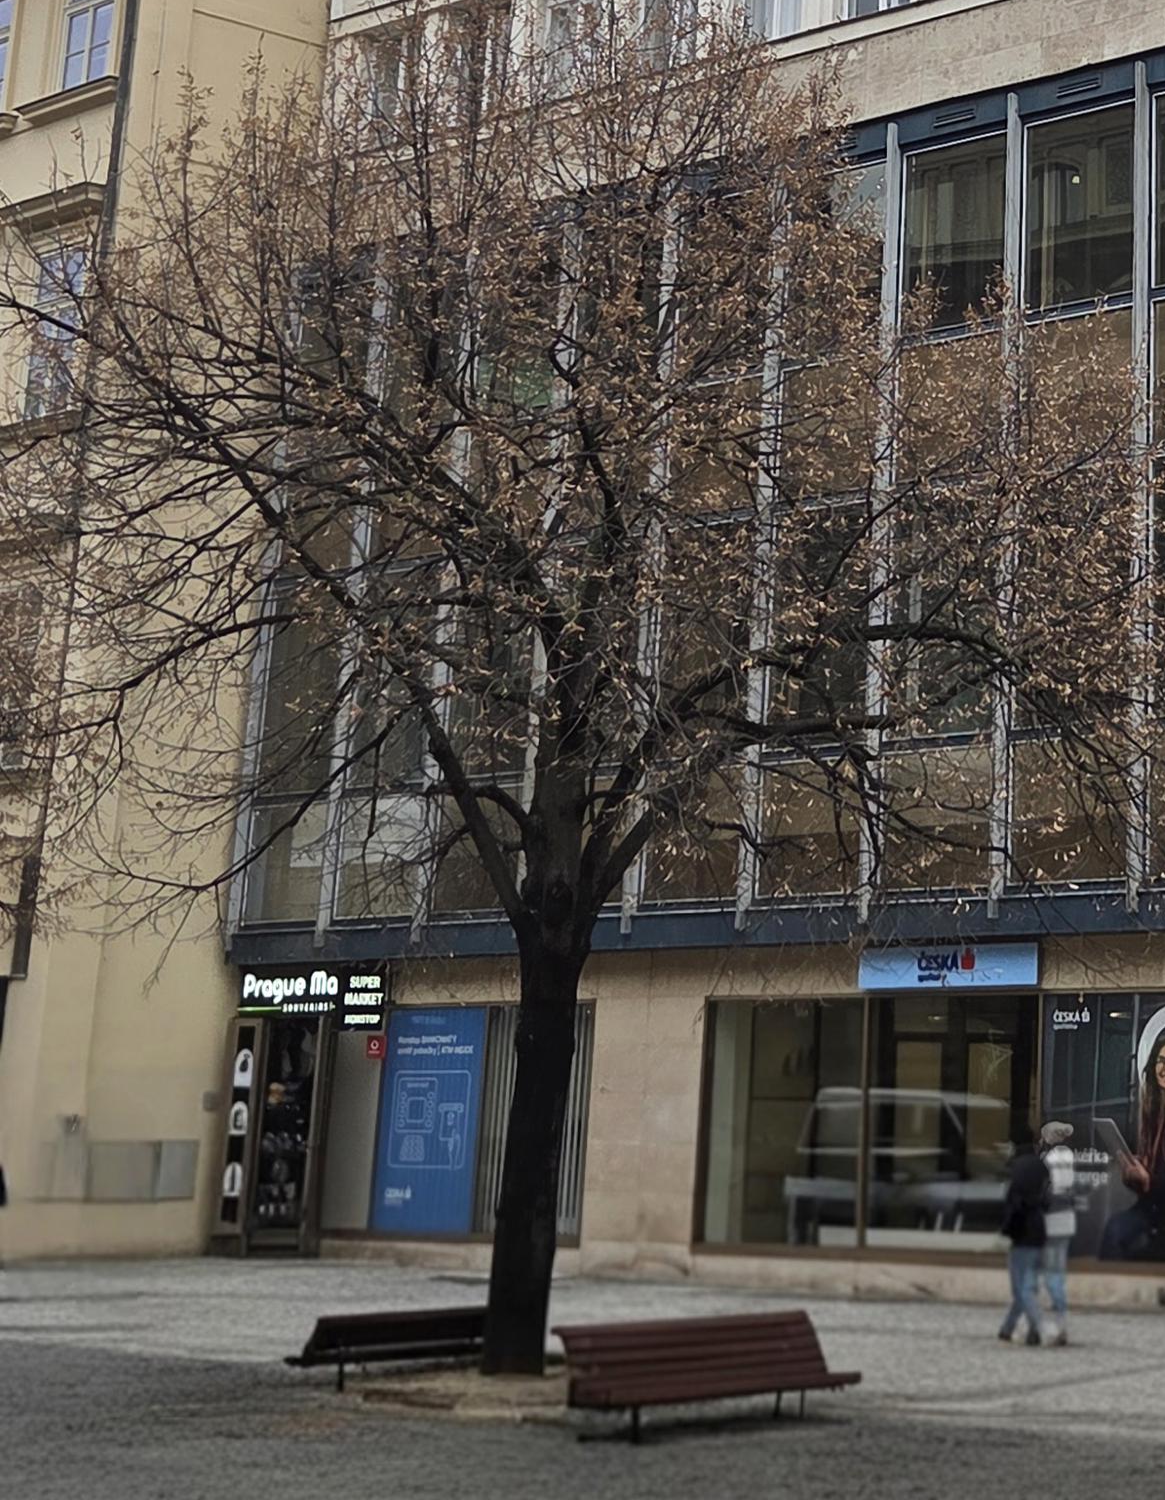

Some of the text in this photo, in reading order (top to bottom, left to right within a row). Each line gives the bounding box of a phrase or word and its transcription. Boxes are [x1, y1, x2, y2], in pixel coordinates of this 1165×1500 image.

[243, 970, 338, 1004] Prague Ma
[350, 976, 381, 988] SUPER
[344, 993, 384, 1005] MARKET
